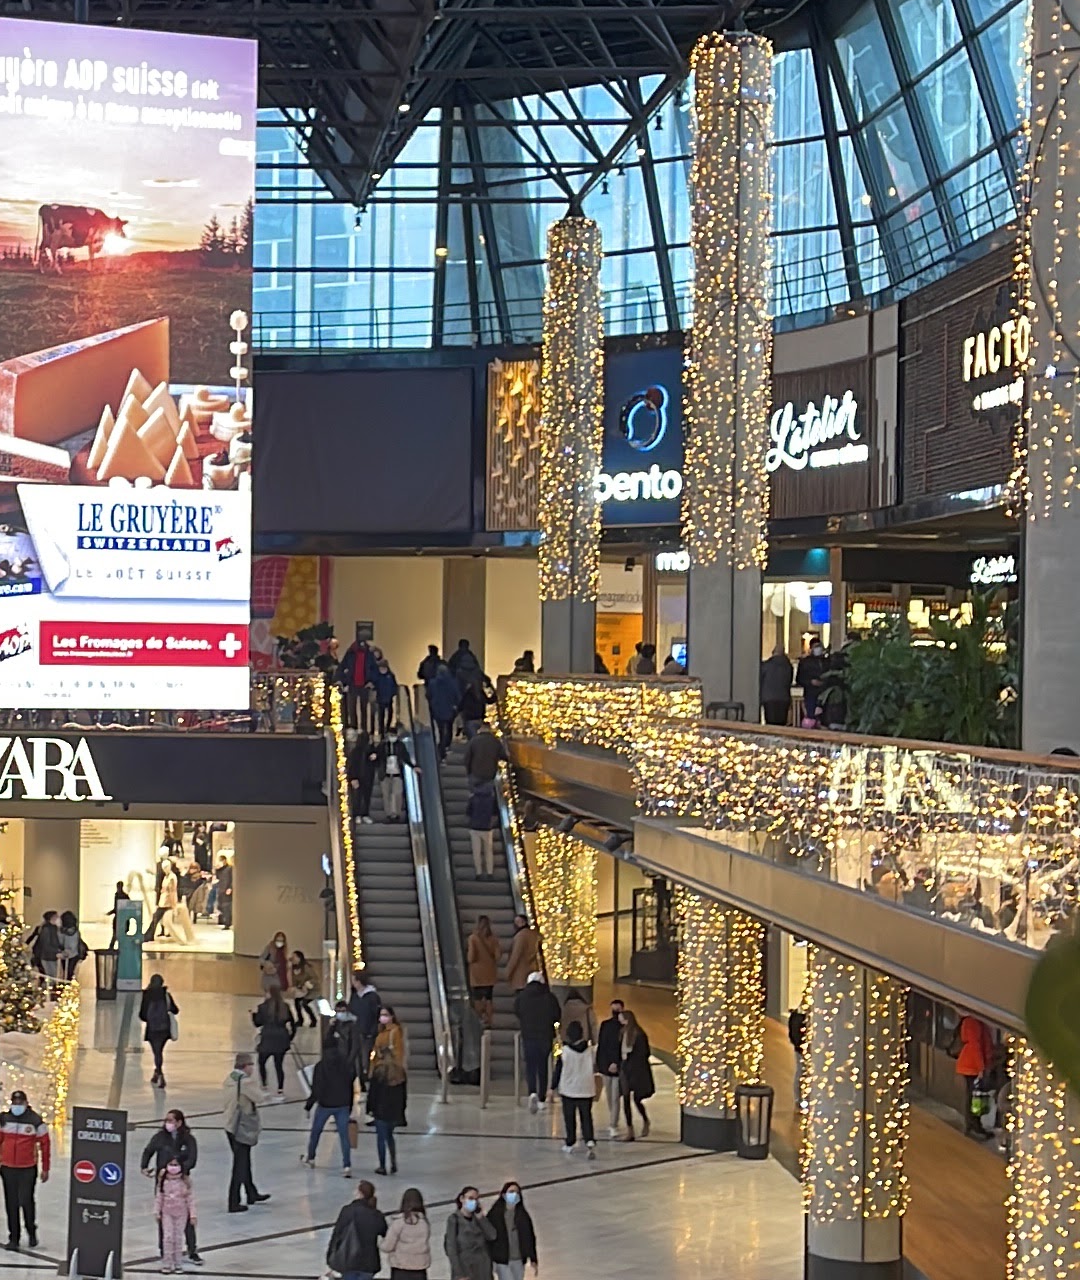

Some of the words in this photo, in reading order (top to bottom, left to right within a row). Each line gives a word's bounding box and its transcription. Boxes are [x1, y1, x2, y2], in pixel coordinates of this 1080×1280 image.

[64, 58, 108, 91] AOP
[112, 61, 188, 98] suisse
[963, 315, 1031, 382] FACTO
[77, 503, 103, 532] LE
[110, 499, 213, 534] GRUYÈRE
[82, 537, 207, 552] SWITZERLAND
[52, 635, 77, 648] Les
[80, 635, 144, 651] Fromages
[145, 636, 163, 650] de
[86, 1118, 103, 1129] SENS
[103, 1120, 113, 1130] DE
[77, 1130, 121, 1142] CIRCULATION
